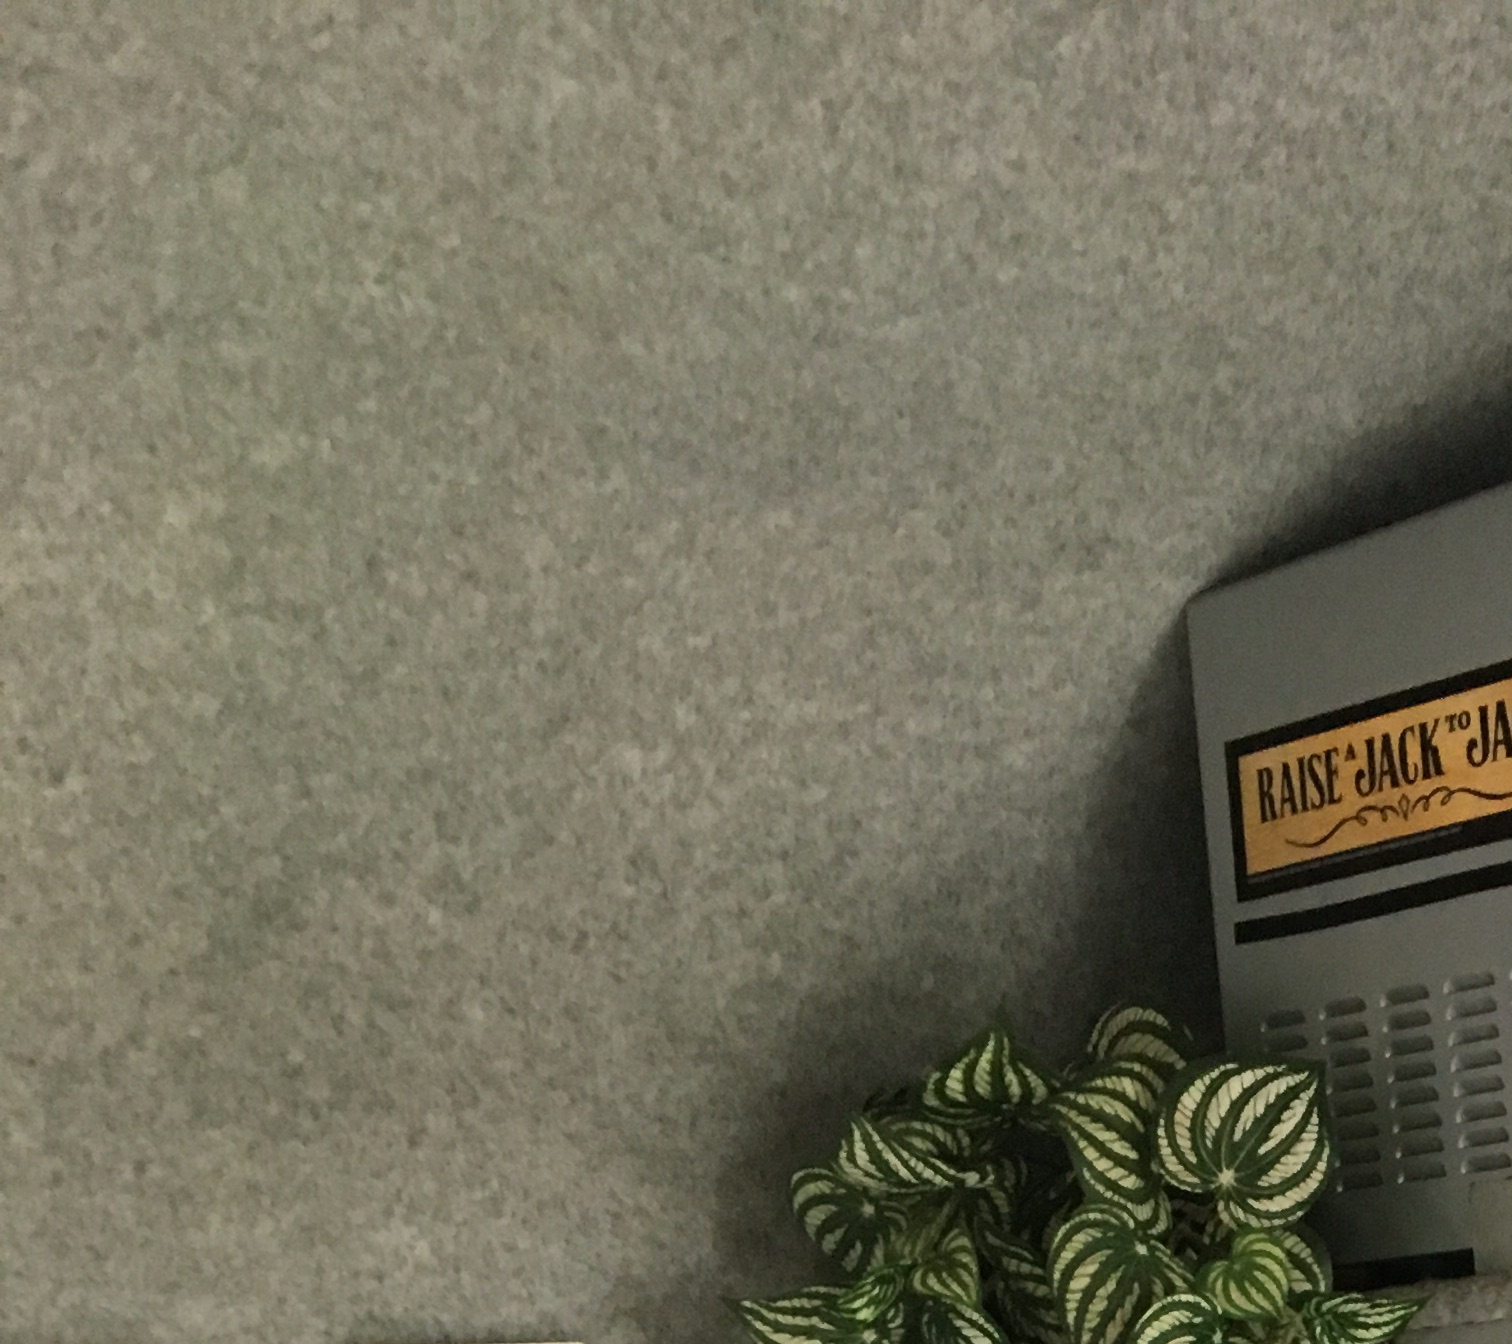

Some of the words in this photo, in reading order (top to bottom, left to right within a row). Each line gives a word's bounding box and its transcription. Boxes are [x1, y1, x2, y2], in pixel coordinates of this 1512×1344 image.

[1256, 747, 1343, 823] RAISE
[1344, 743, 1357, 762] A
[1355, 718, 1446, 797] JACK
[1445, 709, 1472, 732] TO
